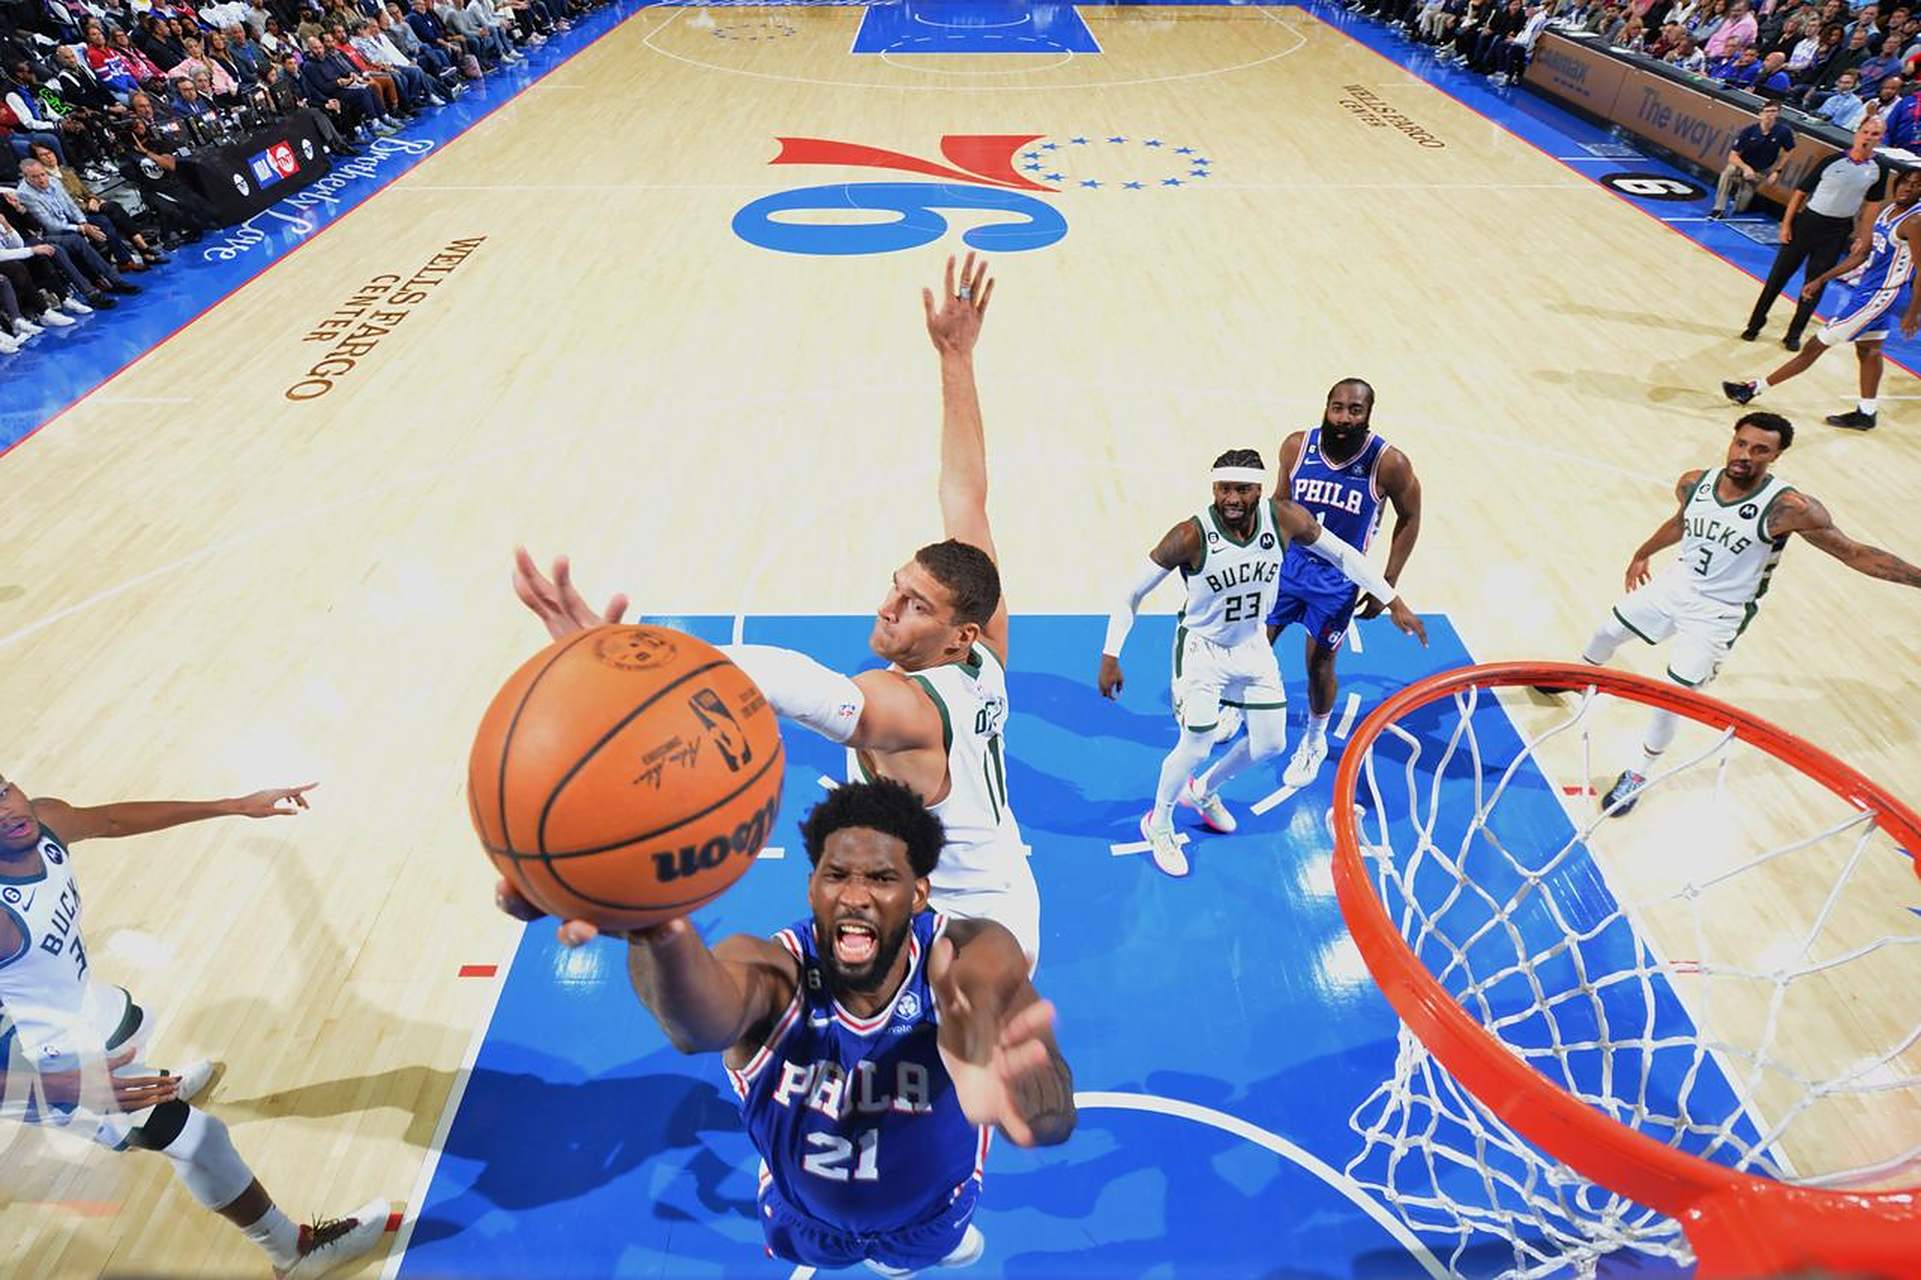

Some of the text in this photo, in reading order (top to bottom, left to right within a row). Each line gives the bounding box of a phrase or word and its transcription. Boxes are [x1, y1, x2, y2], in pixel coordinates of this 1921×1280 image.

[203, 207, 313, 261] Love
[285, 235, 488, 401] WELLS FARGO
[302, 274, 401, 342] CENTER
[1294, 479, 1363, 515] PHILA
[1684, 517, 1752, 555] BUCKS
[1694, 547, 1714, 577] 3
[1206, 561, 1279, 593] BUCKS
[1225, 592, 1262, 622] 23
[40, 876, 82, 957] BUCK
[772, 1058, 934, 1122] PHILA
[803, 1128, 880, 1182] 21
